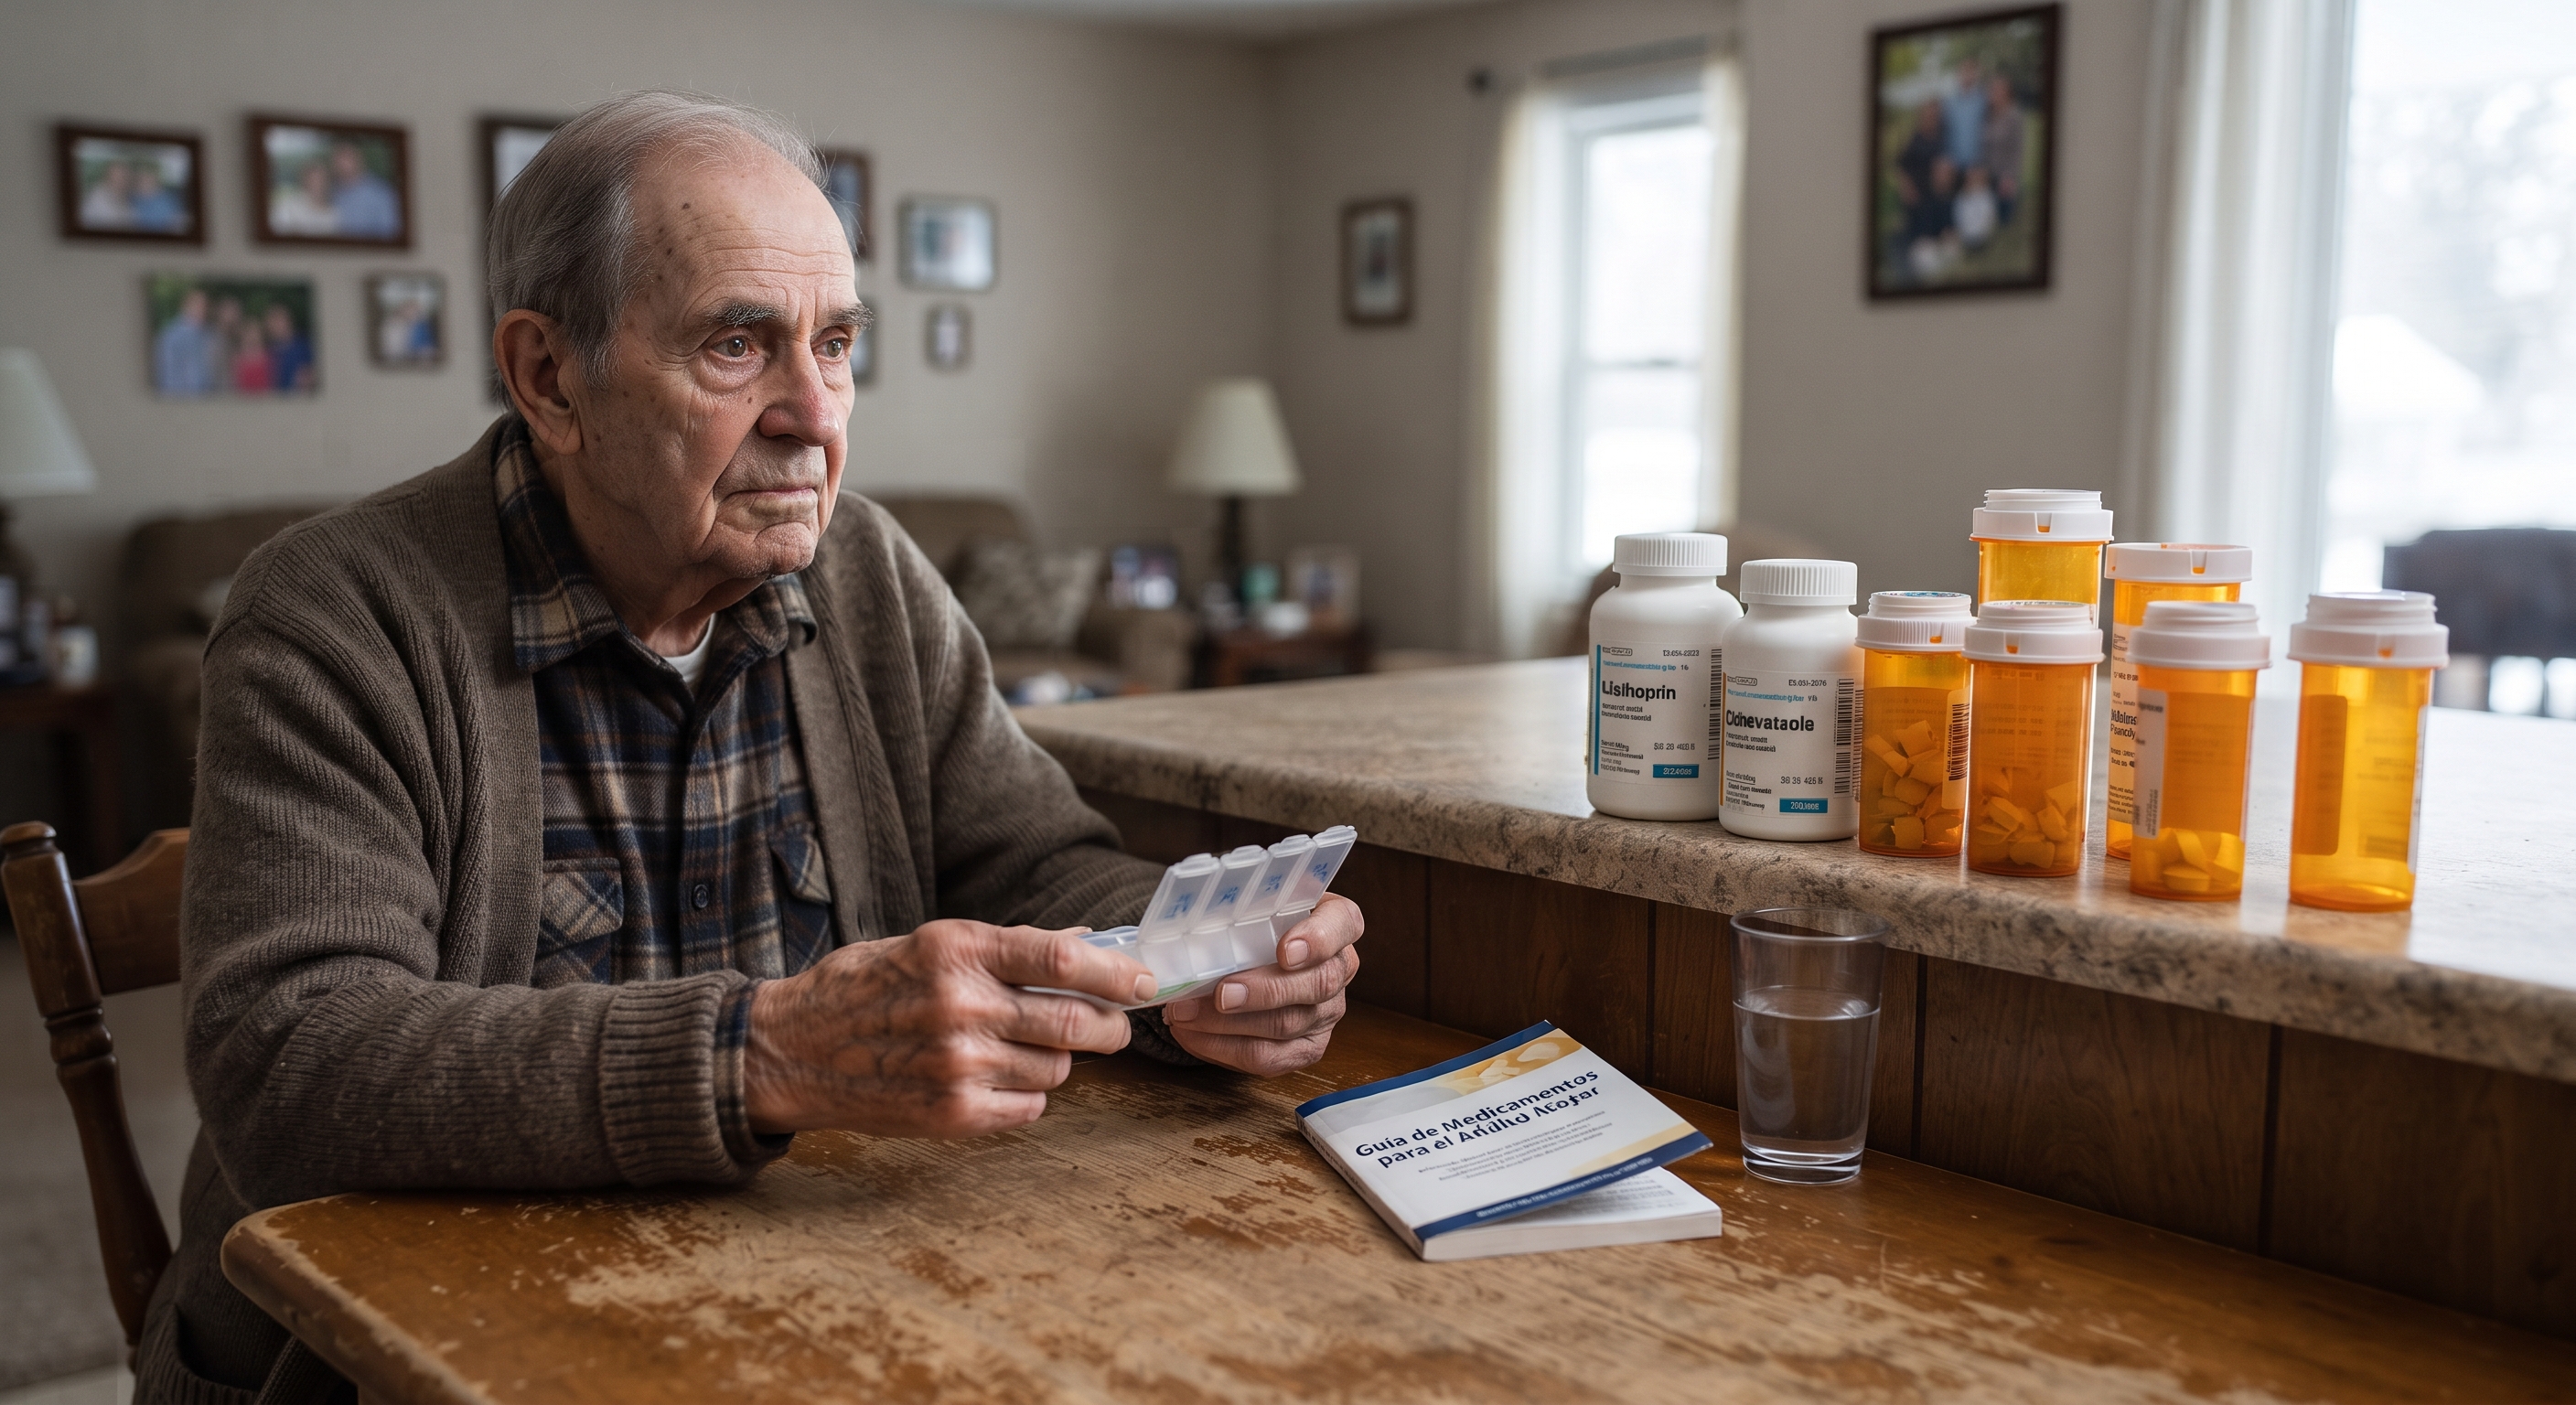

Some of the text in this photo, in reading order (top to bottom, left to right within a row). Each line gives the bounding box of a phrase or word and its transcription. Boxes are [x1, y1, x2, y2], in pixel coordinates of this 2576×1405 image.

[1355, 1070, 1598, 1157] Guía de Medicamentos
[1377, 1146, 1431, 1169] para
